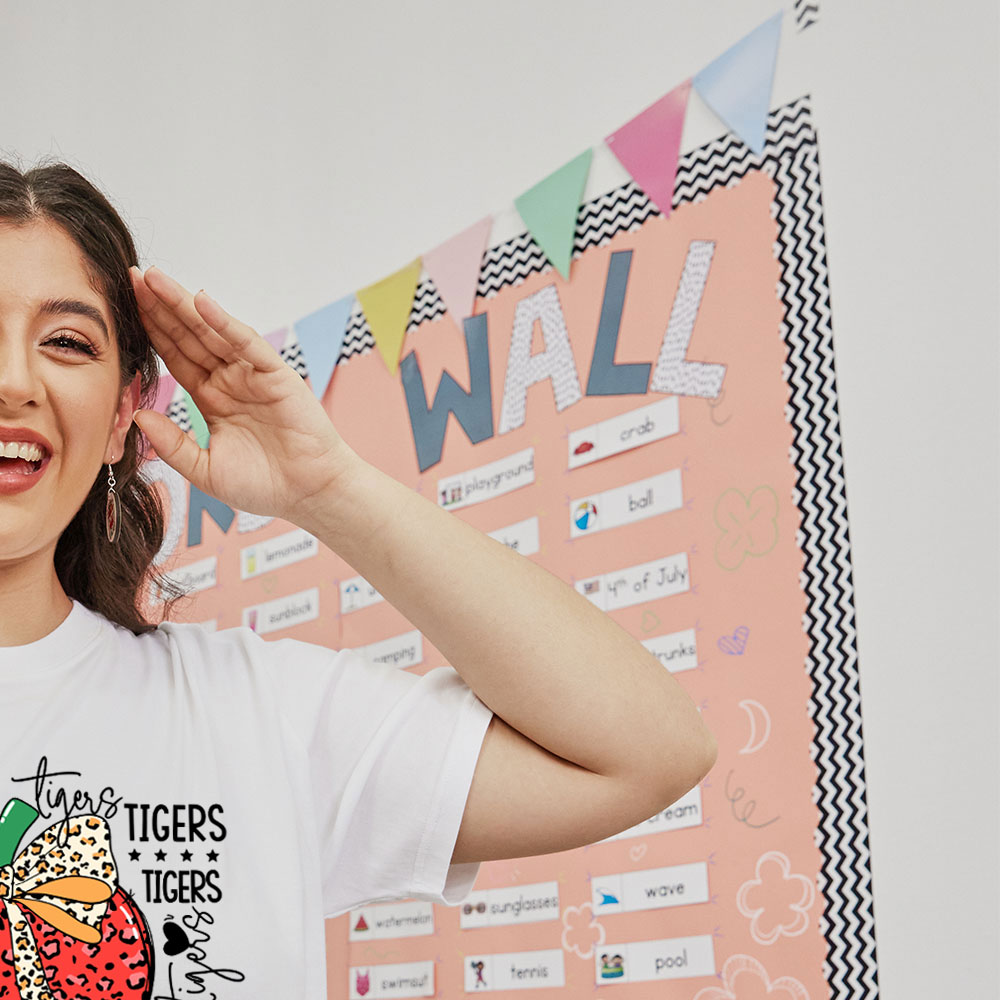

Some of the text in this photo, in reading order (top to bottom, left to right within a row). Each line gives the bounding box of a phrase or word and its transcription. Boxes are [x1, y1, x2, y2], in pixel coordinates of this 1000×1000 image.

[400, 240, 728, 473] WALL
[620, 418, 655, 442] crab
[465, 456, 535, 497] playground
[629, 489, 654, 512] ball
[266, 539, 313, 562] lemonade
[633, 572, 651, 592] of
[657, 565, 687, 588] July
[269, 601, 312, 624] sunblock
[11, 756, 123, 848] tigers
[124, 803, 227, 842] TIGERS
[142, 869, 222, 903] TIGERS
[644, 882, 685, 899] wave
[490, 894, 558, 917] sunglasses
[376, 912, 432, 930] watermelon
[510, 963, 548, 980] tennis
[655, 949, 688, 973] pool
[381, 974, 428, 990] swimsuit
